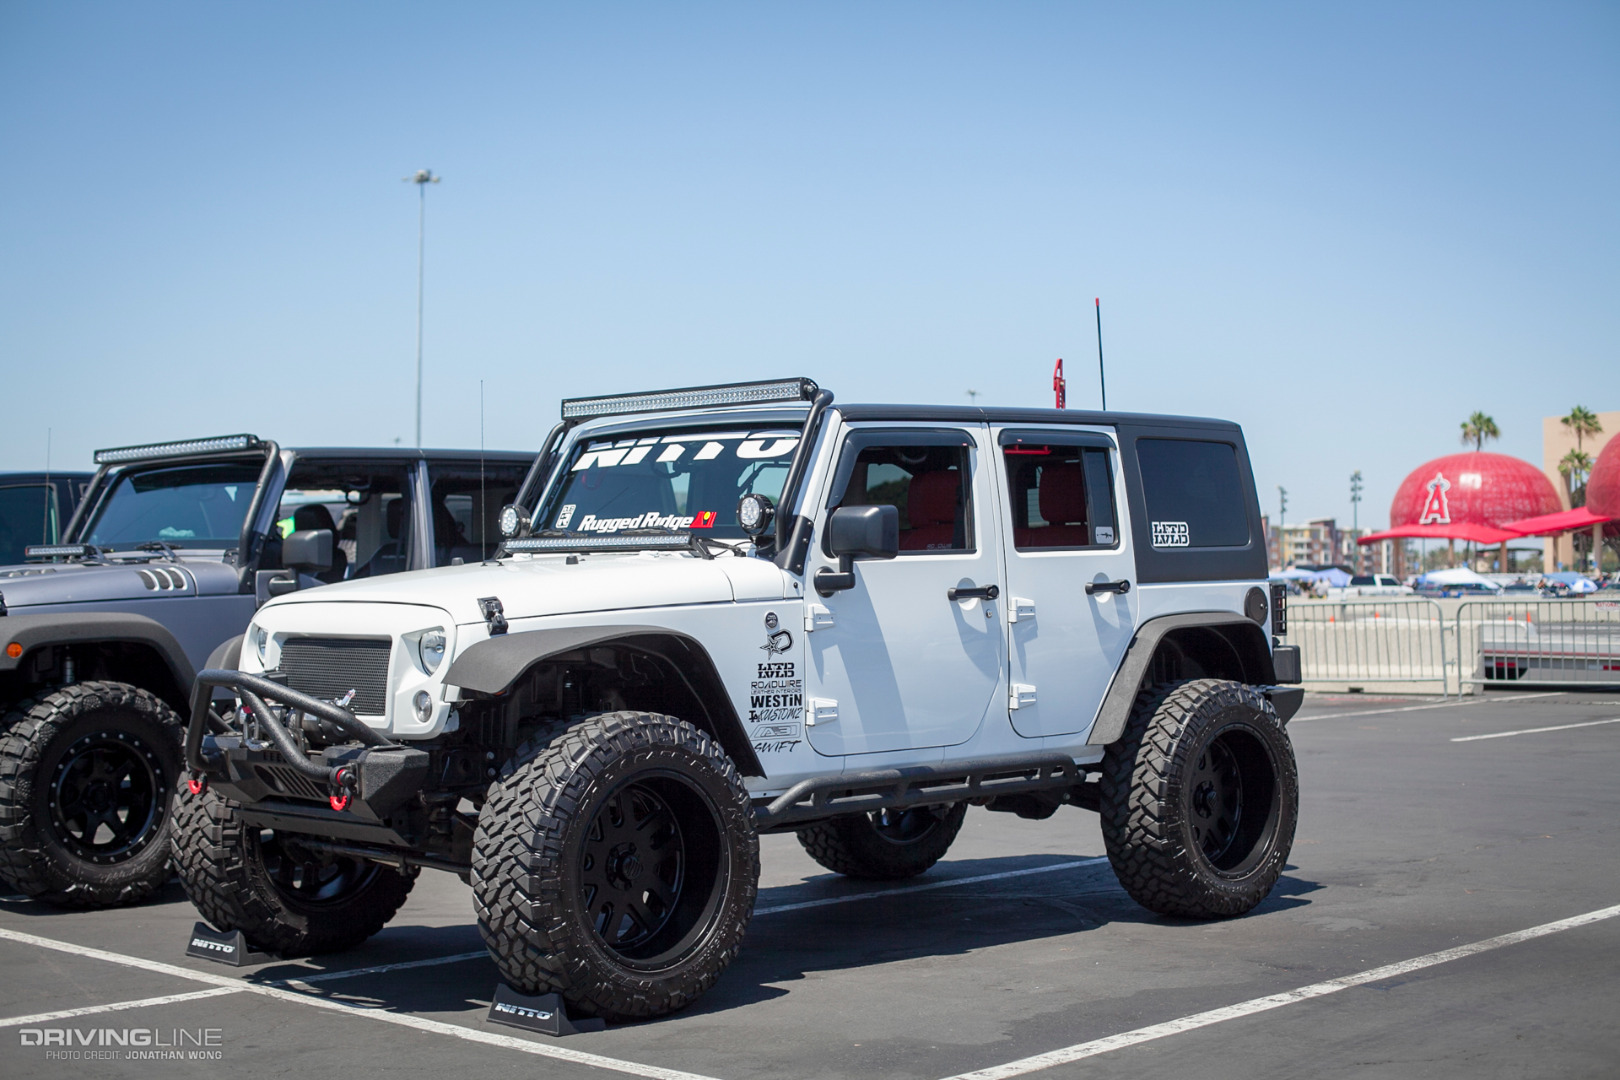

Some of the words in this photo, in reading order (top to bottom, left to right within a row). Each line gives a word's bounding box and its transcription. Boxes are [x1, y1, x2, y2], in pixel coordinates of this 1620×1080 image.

[571, 430, 801, 471] NITTO
[754, 740, 802, 753] SWIFT
[192, 938, 236, 953] NITTO
[495, 1003, 553, 1020] NITTO
